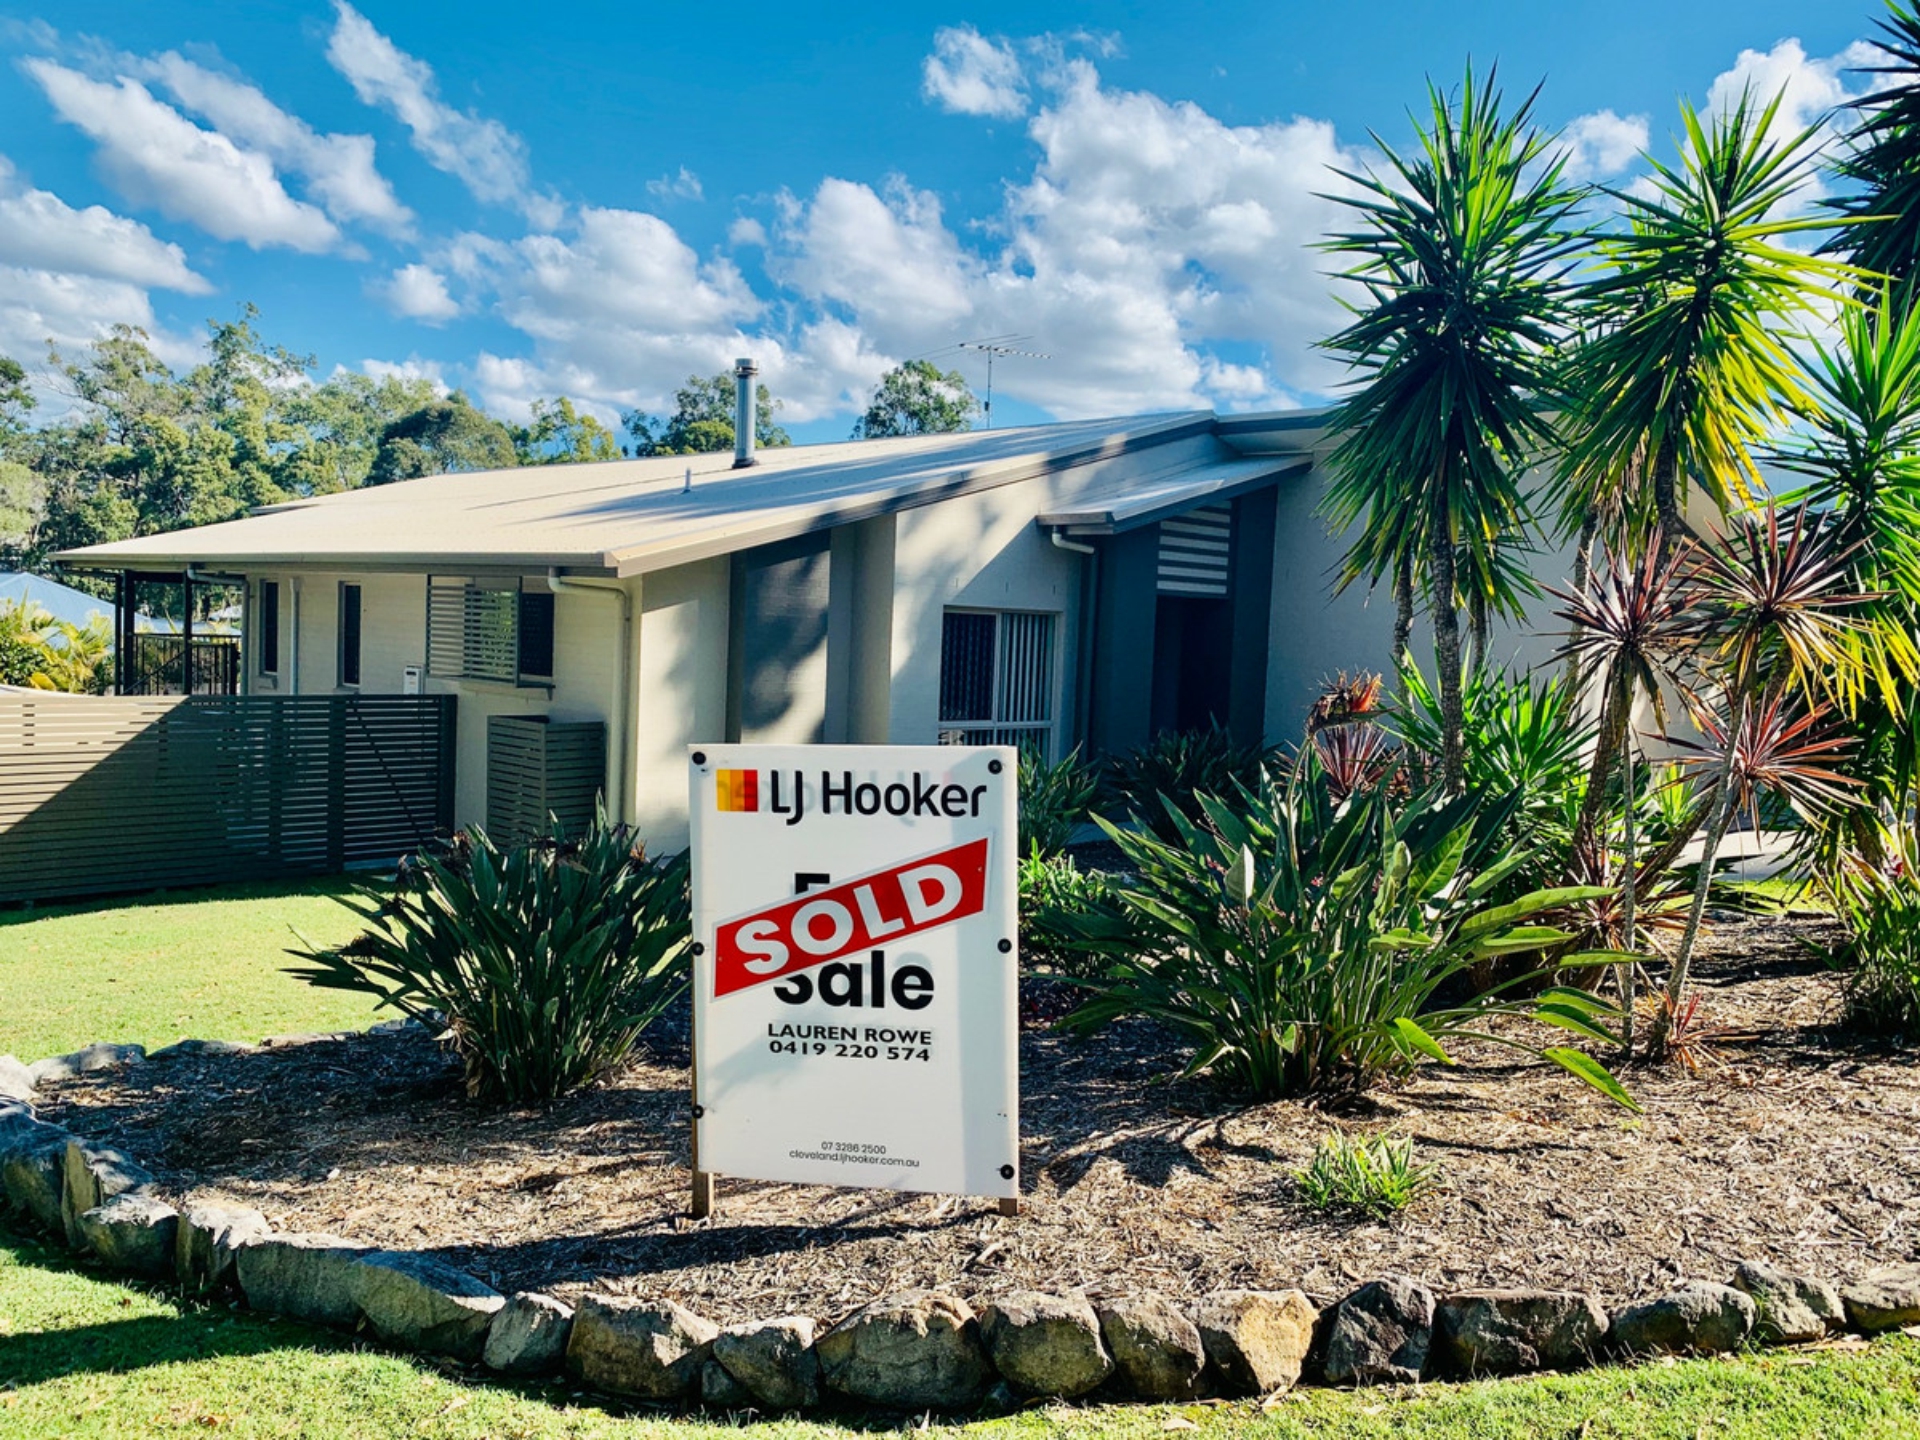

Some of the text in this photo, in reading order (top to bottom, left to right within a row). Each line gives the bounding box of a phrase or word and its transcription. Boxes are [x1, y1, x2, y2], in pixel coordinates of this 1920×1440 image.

[770, 769, 987, 826] LJ Hooker
[735, 864, 963, 975] SOLD
[768, 1023, 932, 1045] LAUREN ROWE
[769, 1040, 929, 1062] 0419 220 574
[821, 1141, 833, 1150] 07
[861, 1144, 886, 1155] 2500
